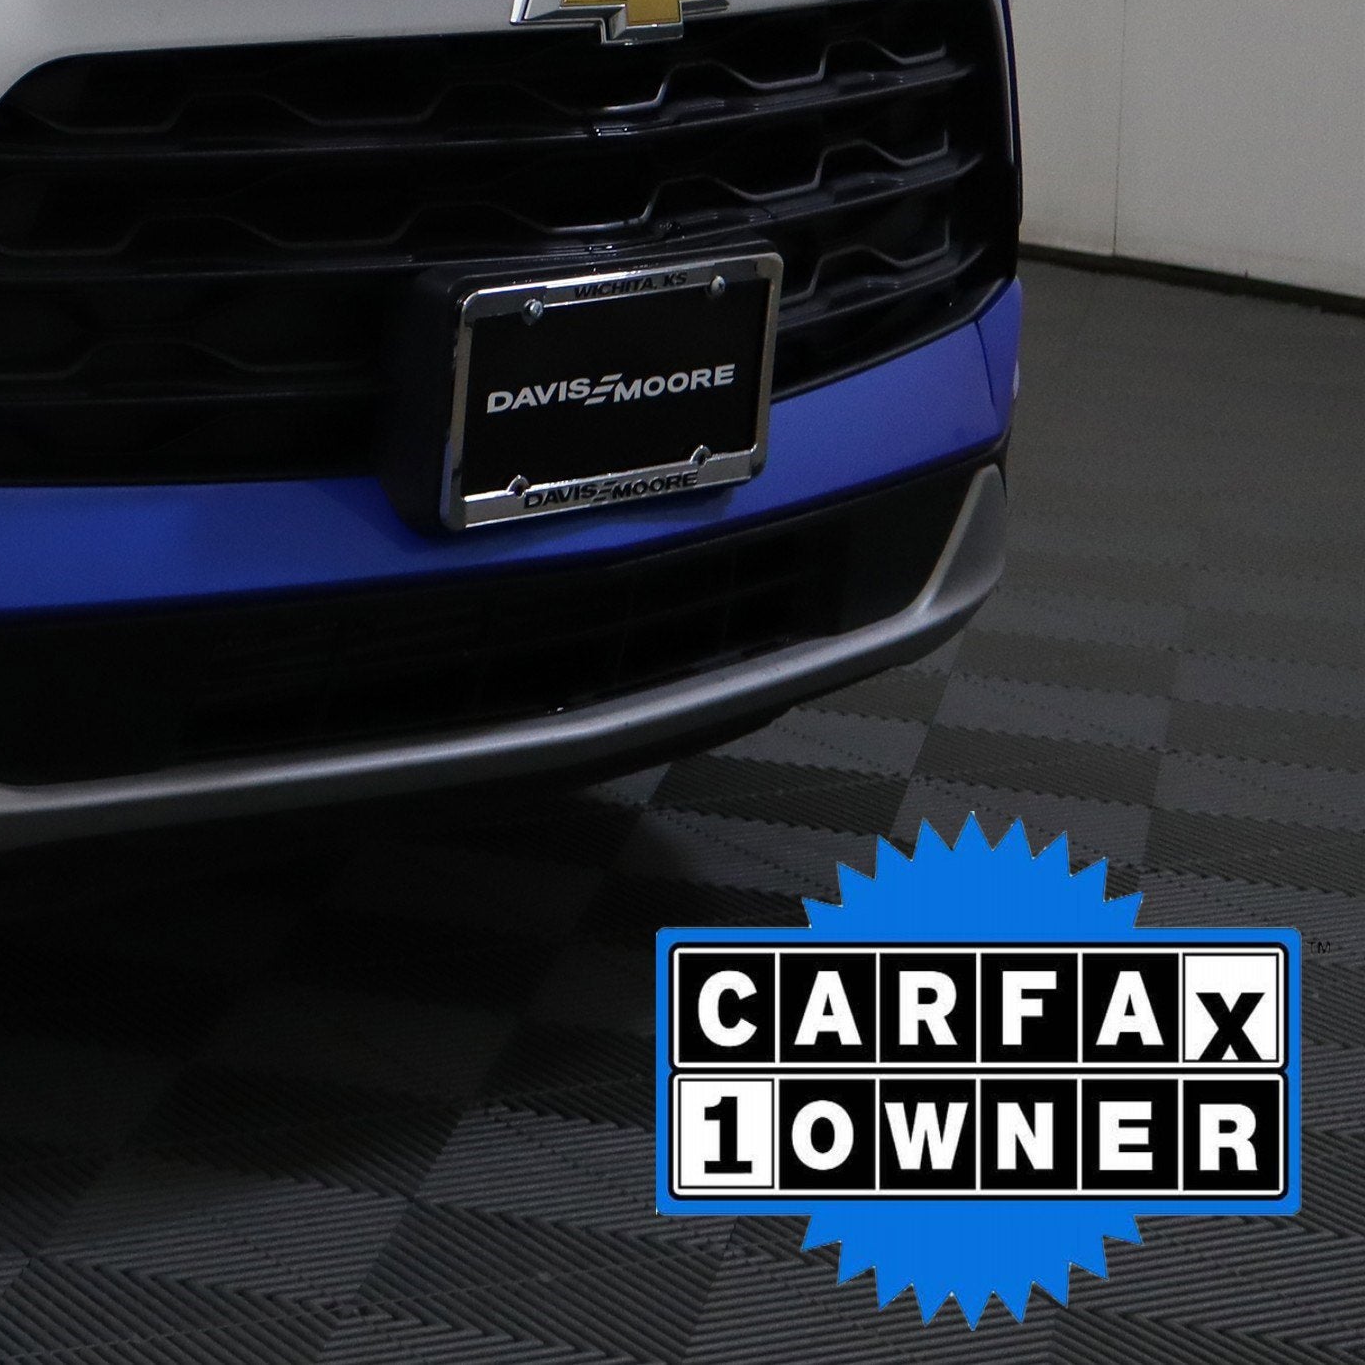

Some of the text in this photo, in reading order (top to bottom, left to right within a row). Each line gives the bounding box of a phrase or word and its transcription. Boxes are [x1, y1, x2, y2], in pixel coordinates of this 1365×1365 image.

[573, 271, 688, 299] WICHITA, KS
[486, 363, 736, 414] DAVIS MOORE
[523, 470, 699, 510] DAVIS MOORE
